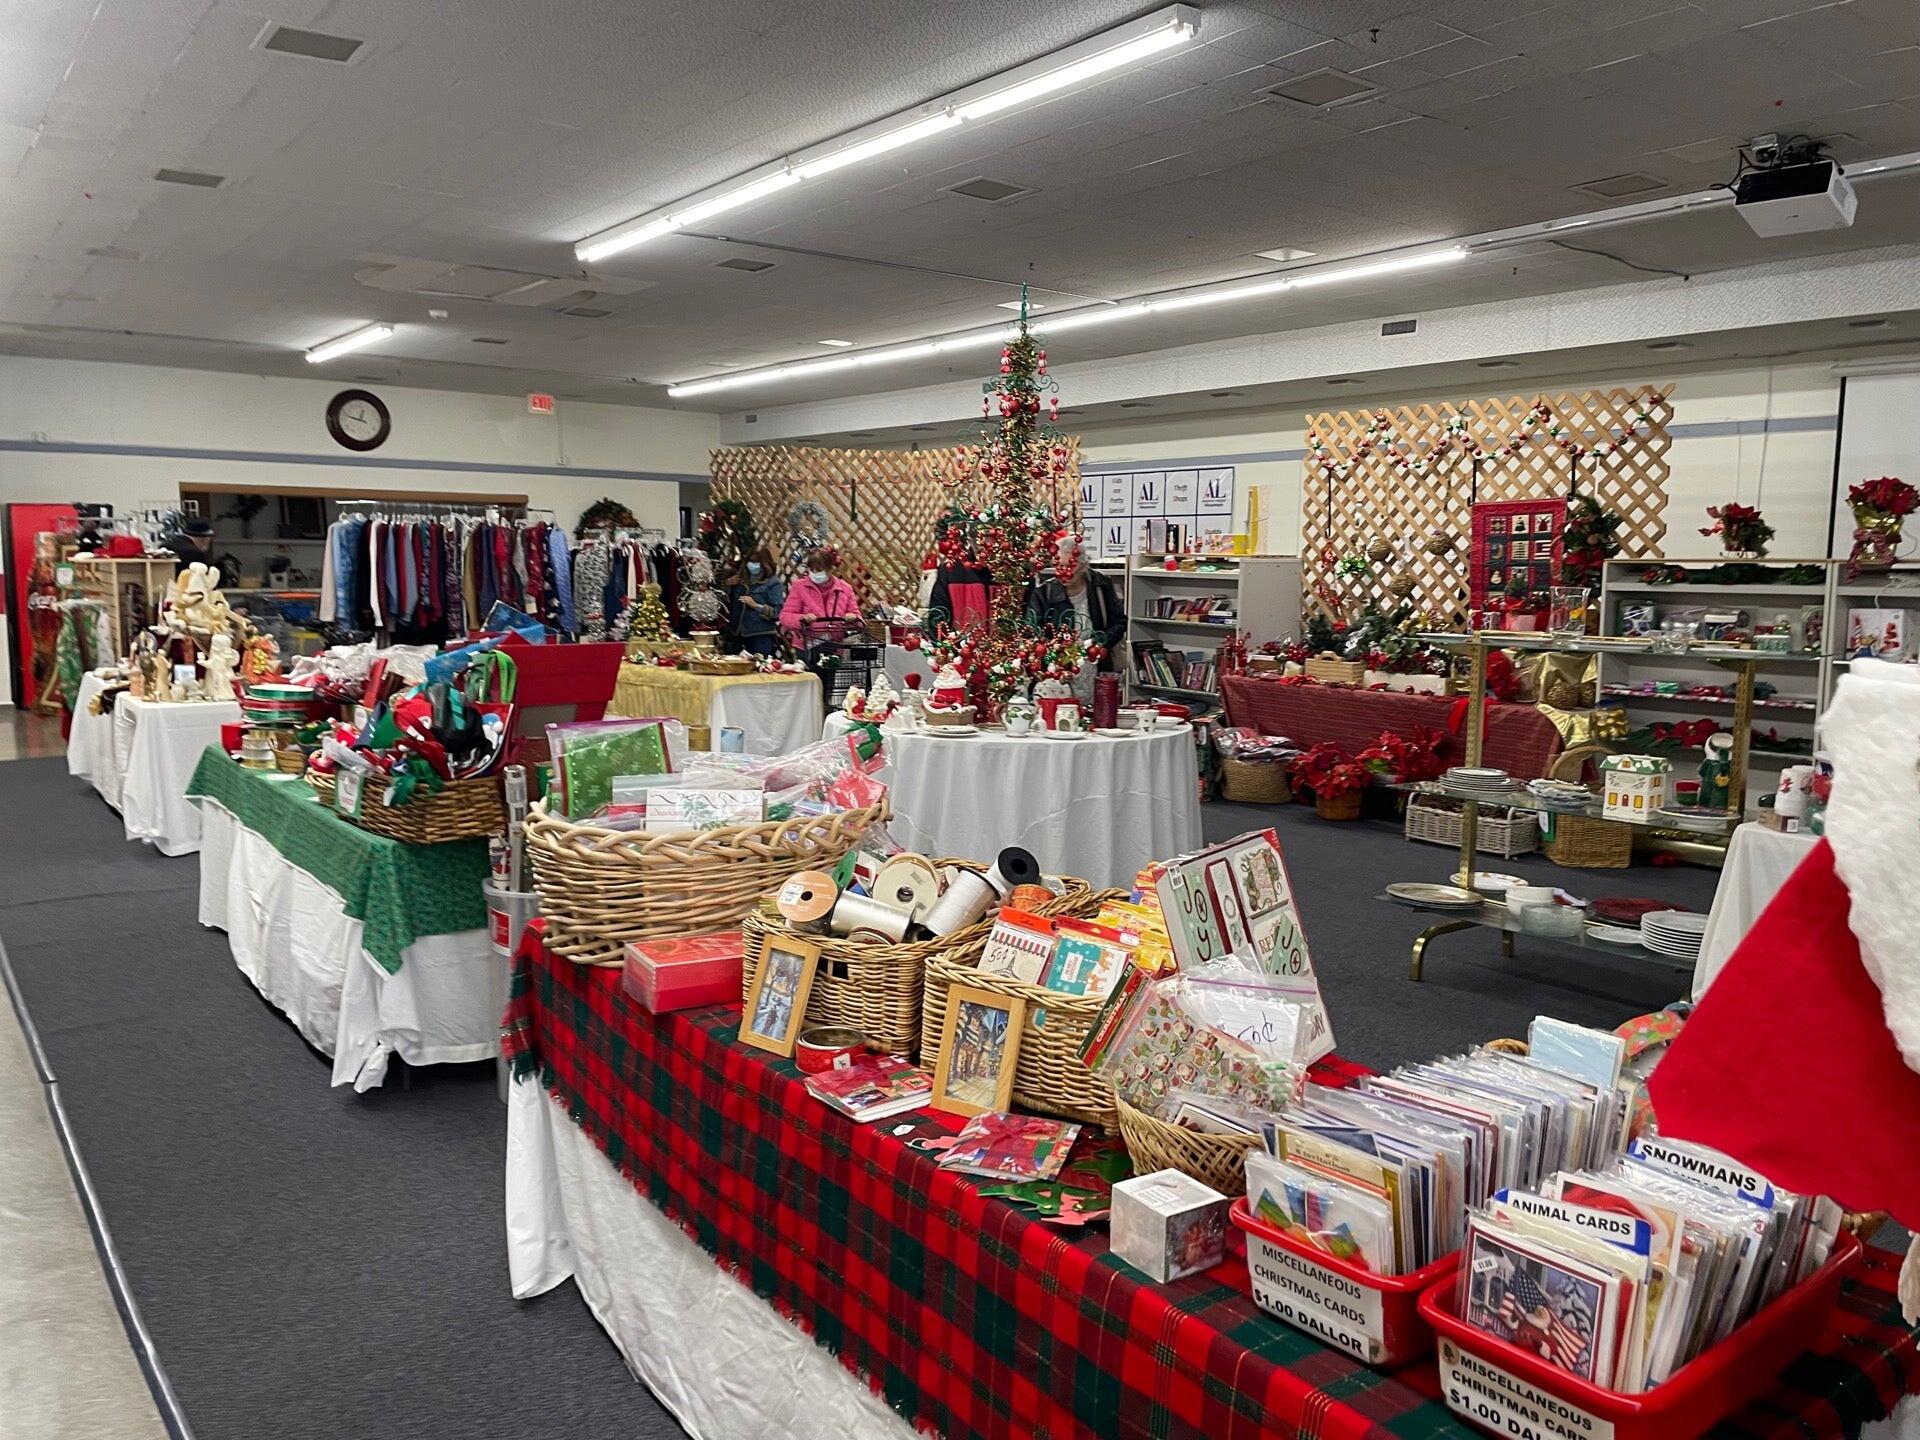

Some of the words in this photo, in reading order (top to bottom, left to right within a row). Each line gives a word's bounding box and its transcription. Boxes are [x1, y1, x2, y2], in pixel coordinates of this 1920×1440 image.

[1140, 481, 1159, 501] AL
[1108, 526, 1126, 545] AL
[1642, 1143, 1757, 1192] SNOWMANS
[1511, 1198, 1570, 1223] ANIMAL
[1575, 1213, 1631, 1236] CARDS
[1254, 1264, 1321, 1304] CHRISTMAS
[1324, 1297, 1366, 1325] CARDS
[1262, 1244, 1361, 1299] MISCELLANEOUS
[1254, 1288, 1293, 1318] $1.00
[1298, 1311, 1363, 1355] DALLOR
[1450, 1388, 1501, 1425] $1.00
[1452, 1369, 1540, 1423] CHRISTMAS
[1460, 1355, 1593, 1431] MISCELLANEOUS
